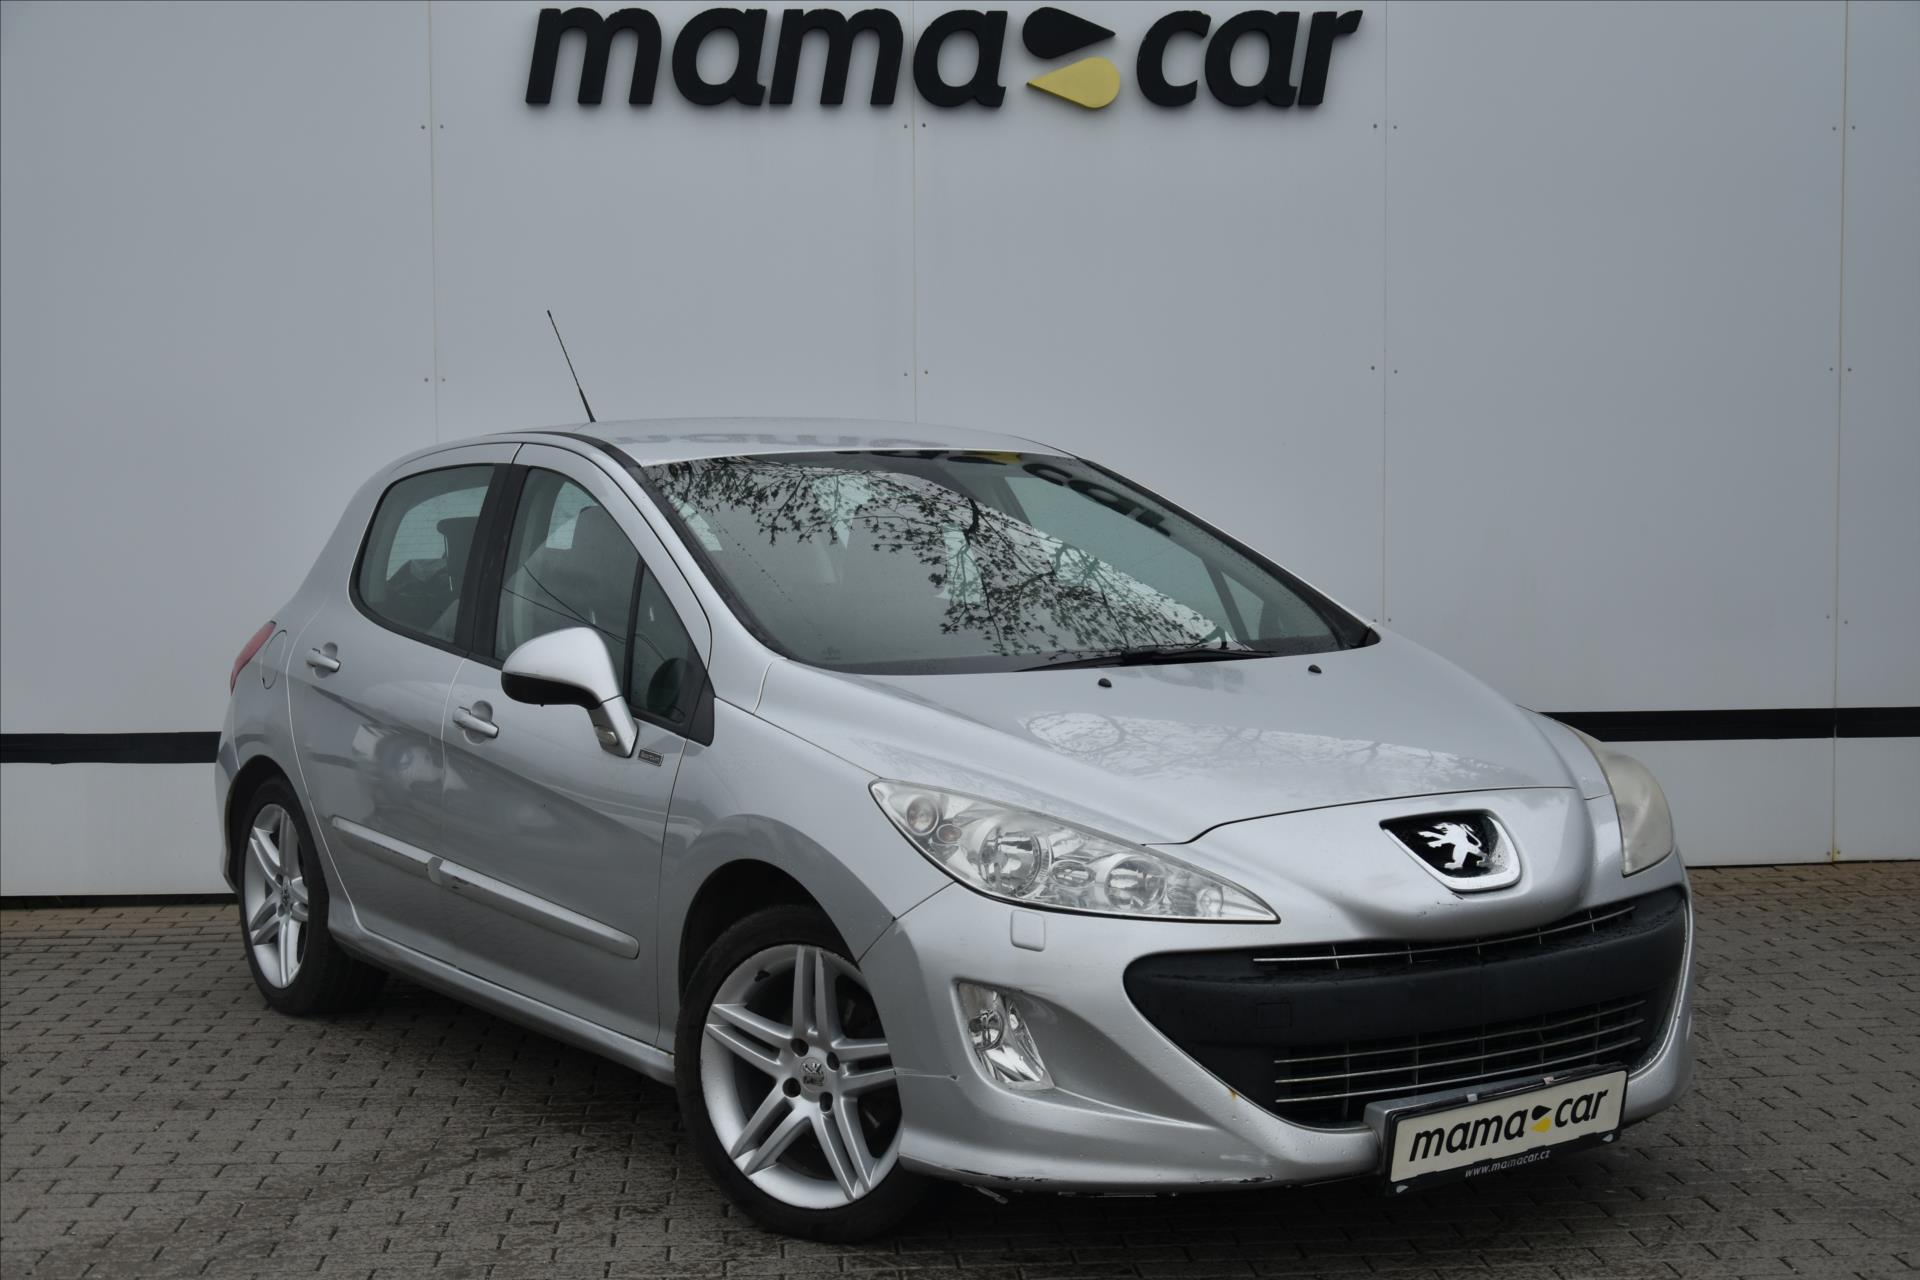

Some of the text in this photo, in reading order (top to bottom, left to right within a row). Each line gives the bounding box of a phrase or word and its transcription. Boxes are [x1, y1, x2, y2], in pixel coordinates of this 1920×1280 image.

[525, 7, 1364, 109] mama car
[1408, 1089, 1609, 1162] mama car
[1464, 1150, 1551, 1178] www.mamacar.cz
